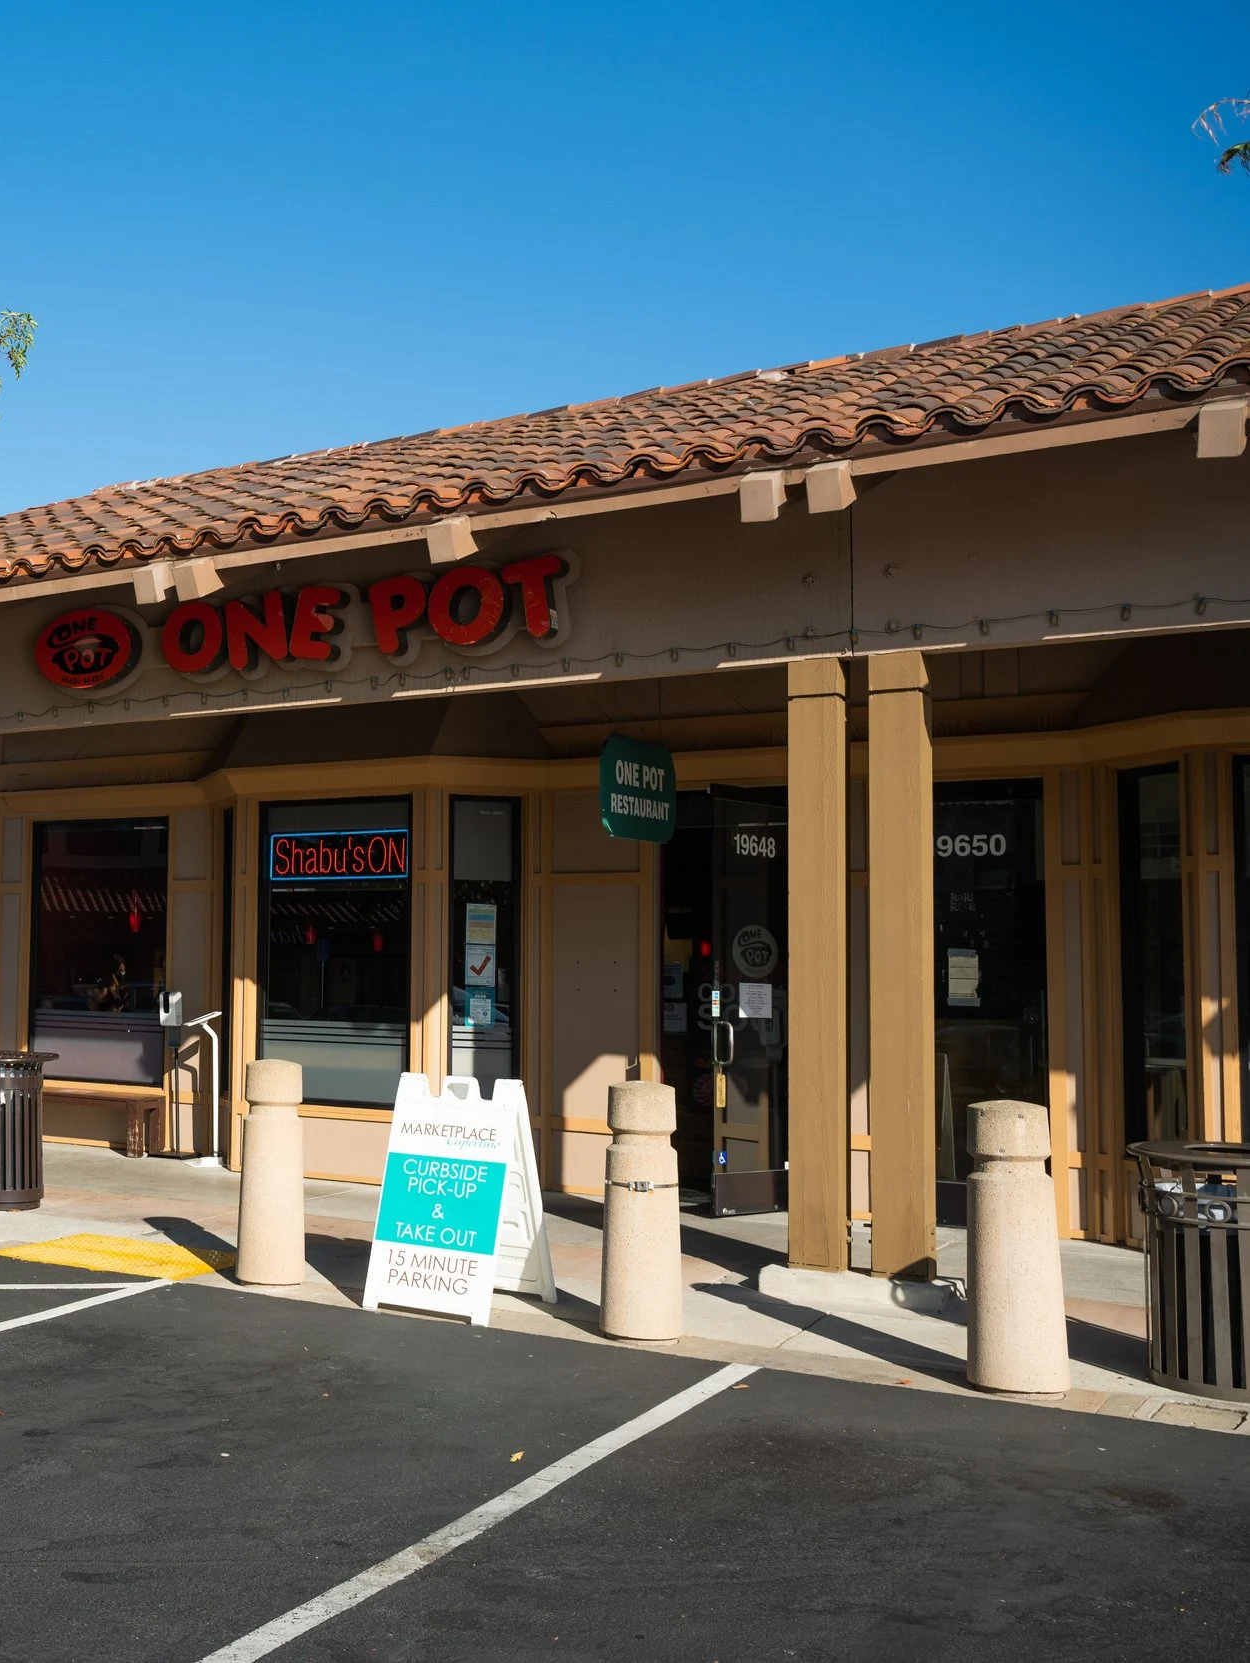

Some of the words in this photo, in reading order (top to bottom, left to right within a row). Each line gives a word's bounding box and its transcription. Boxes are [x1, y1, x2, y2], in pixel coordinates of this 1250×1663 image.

[161, 585, 341, 673] ONE
[370, 555, 564, 655] POT
[48, 616, 97, 648] ONE
[64, 648, 112, 671] POT
[616, 759, 640, 787] ONE
[643, 764, 665, 792] POT
[611, 793, 670, 821] RESTAURANT
[734, 833, 776, 858] 19648
[936, 834, 1007, 857] 9650
[738, 928, 762, 947] ONE
[745, 948, 769, 964] POT
[400, 1122, 497, 1141] MARKETPLACE
[403, 1159, 489, 1182] CURBSIDE
[407, 1177, 477, 1199] PICK-UP
[431, 1203, 445, 1219] &
[395, 1221, 436, 1243] TAKE
[440, 1227, 477, 1248] OUT
[388, 1249, 406, 1267] 15
[410, 1253, 478, 1277] MINUTE
[388, 1268, 468, 1295] PARKING
